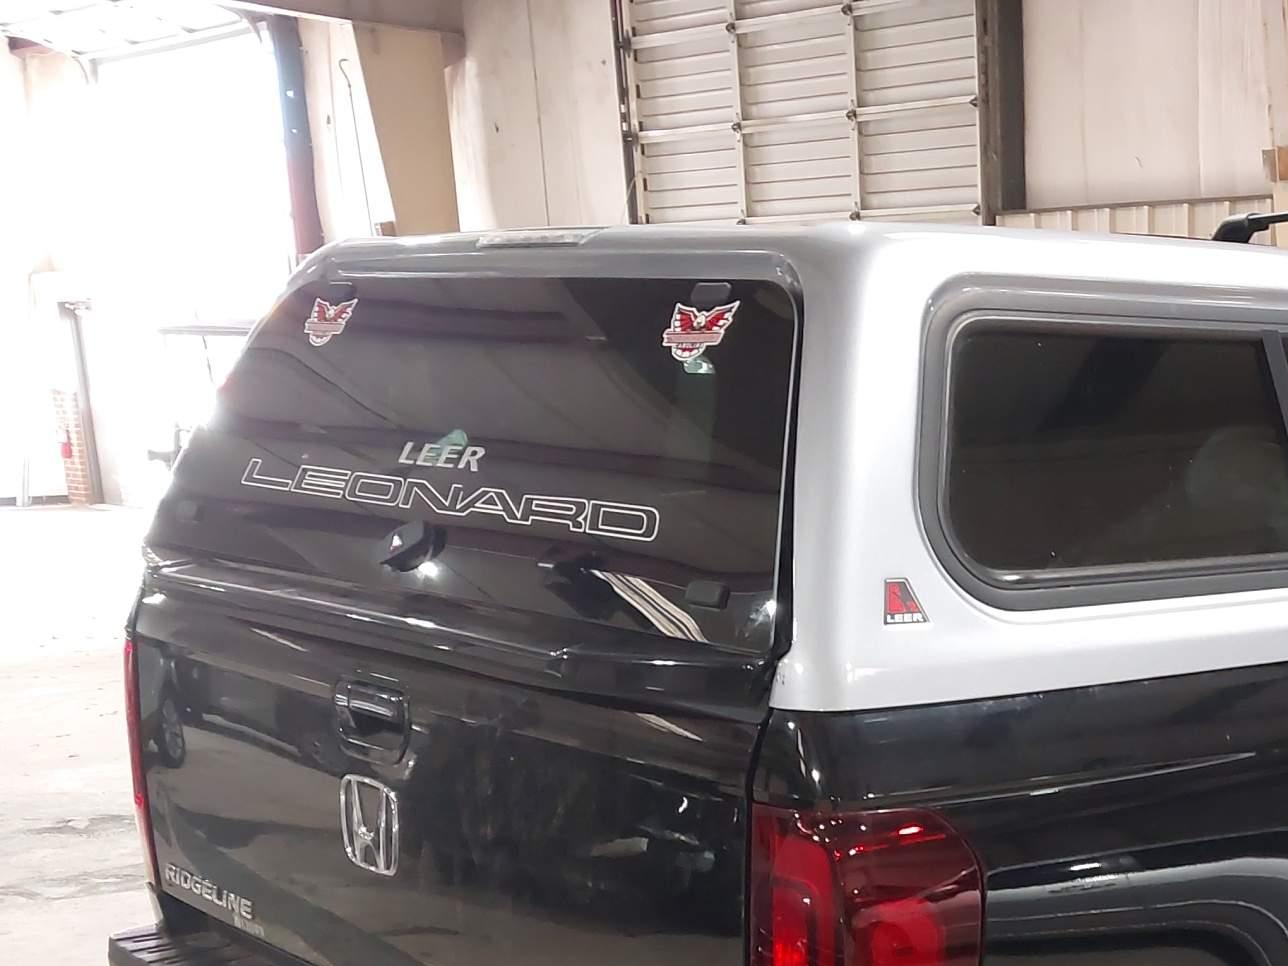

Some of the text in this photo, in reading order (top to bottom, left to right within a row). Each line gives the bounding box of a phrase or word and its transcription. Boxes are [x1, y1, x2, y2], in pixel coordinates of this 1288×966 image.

[398, 441, 486, 472] LEER
[241, 457, 661, 542] LEONARD
[165, 863, 254, 920] RIDGELINE
